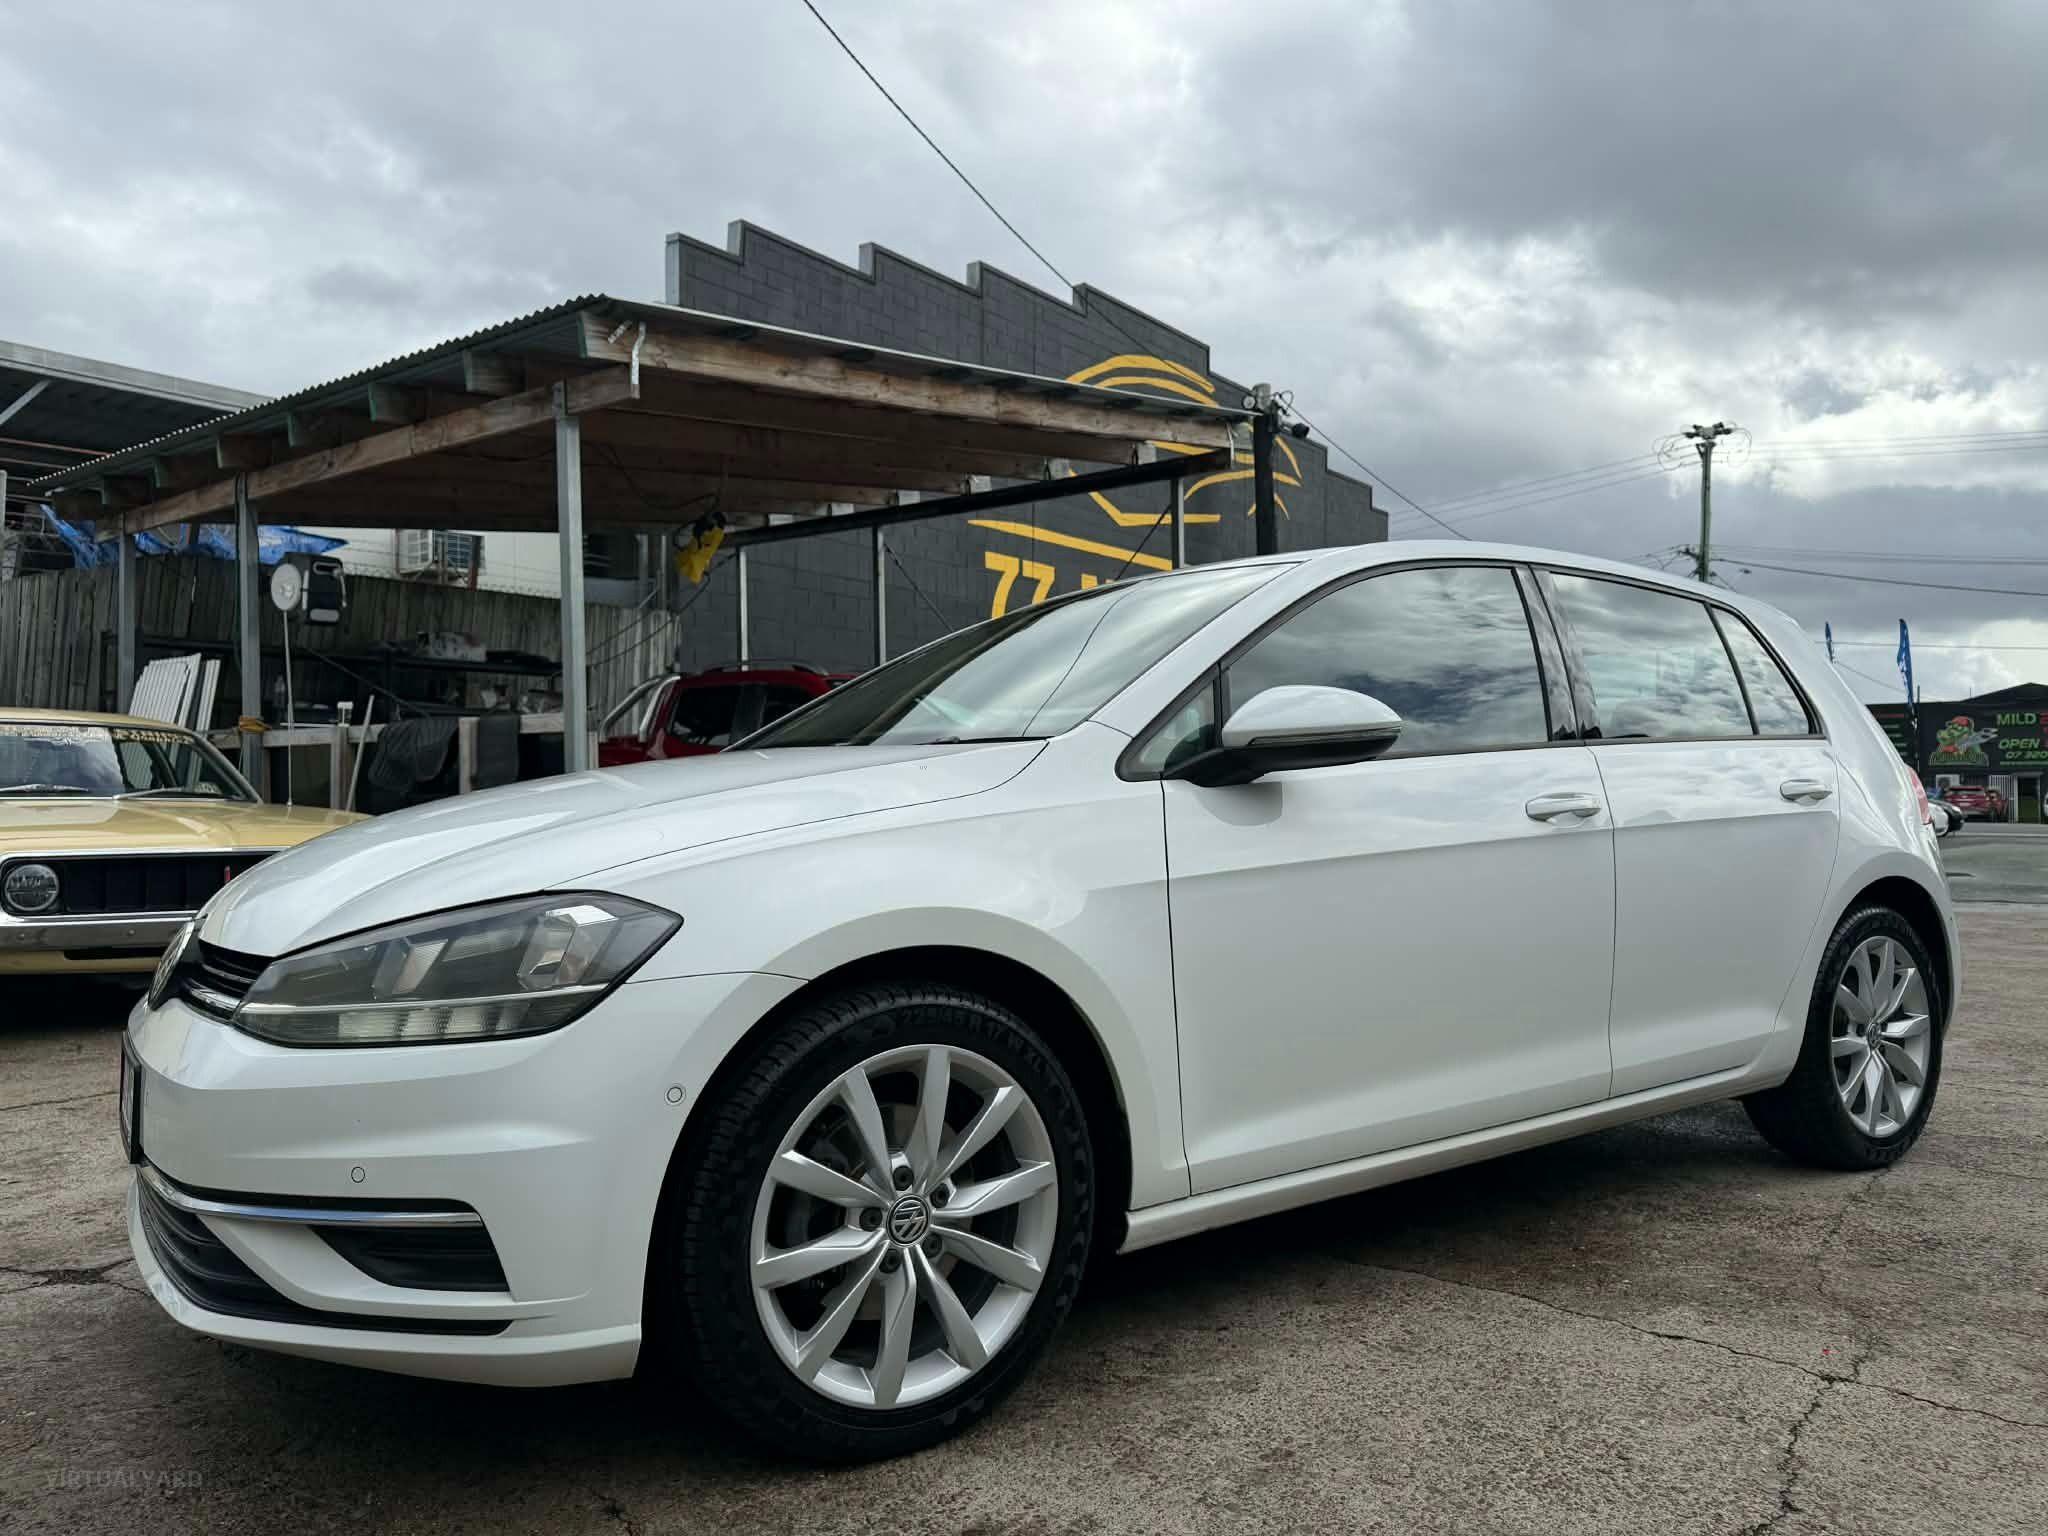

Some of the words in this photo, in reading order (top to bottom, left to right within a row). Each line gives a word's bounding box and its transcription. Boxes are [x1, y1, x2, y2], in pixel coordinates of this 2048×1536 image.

[985, 551, 1055, 619] 77
[1997, 712, 2037, 725] MILD
[1998, 738, 2040, 749] OPEN
